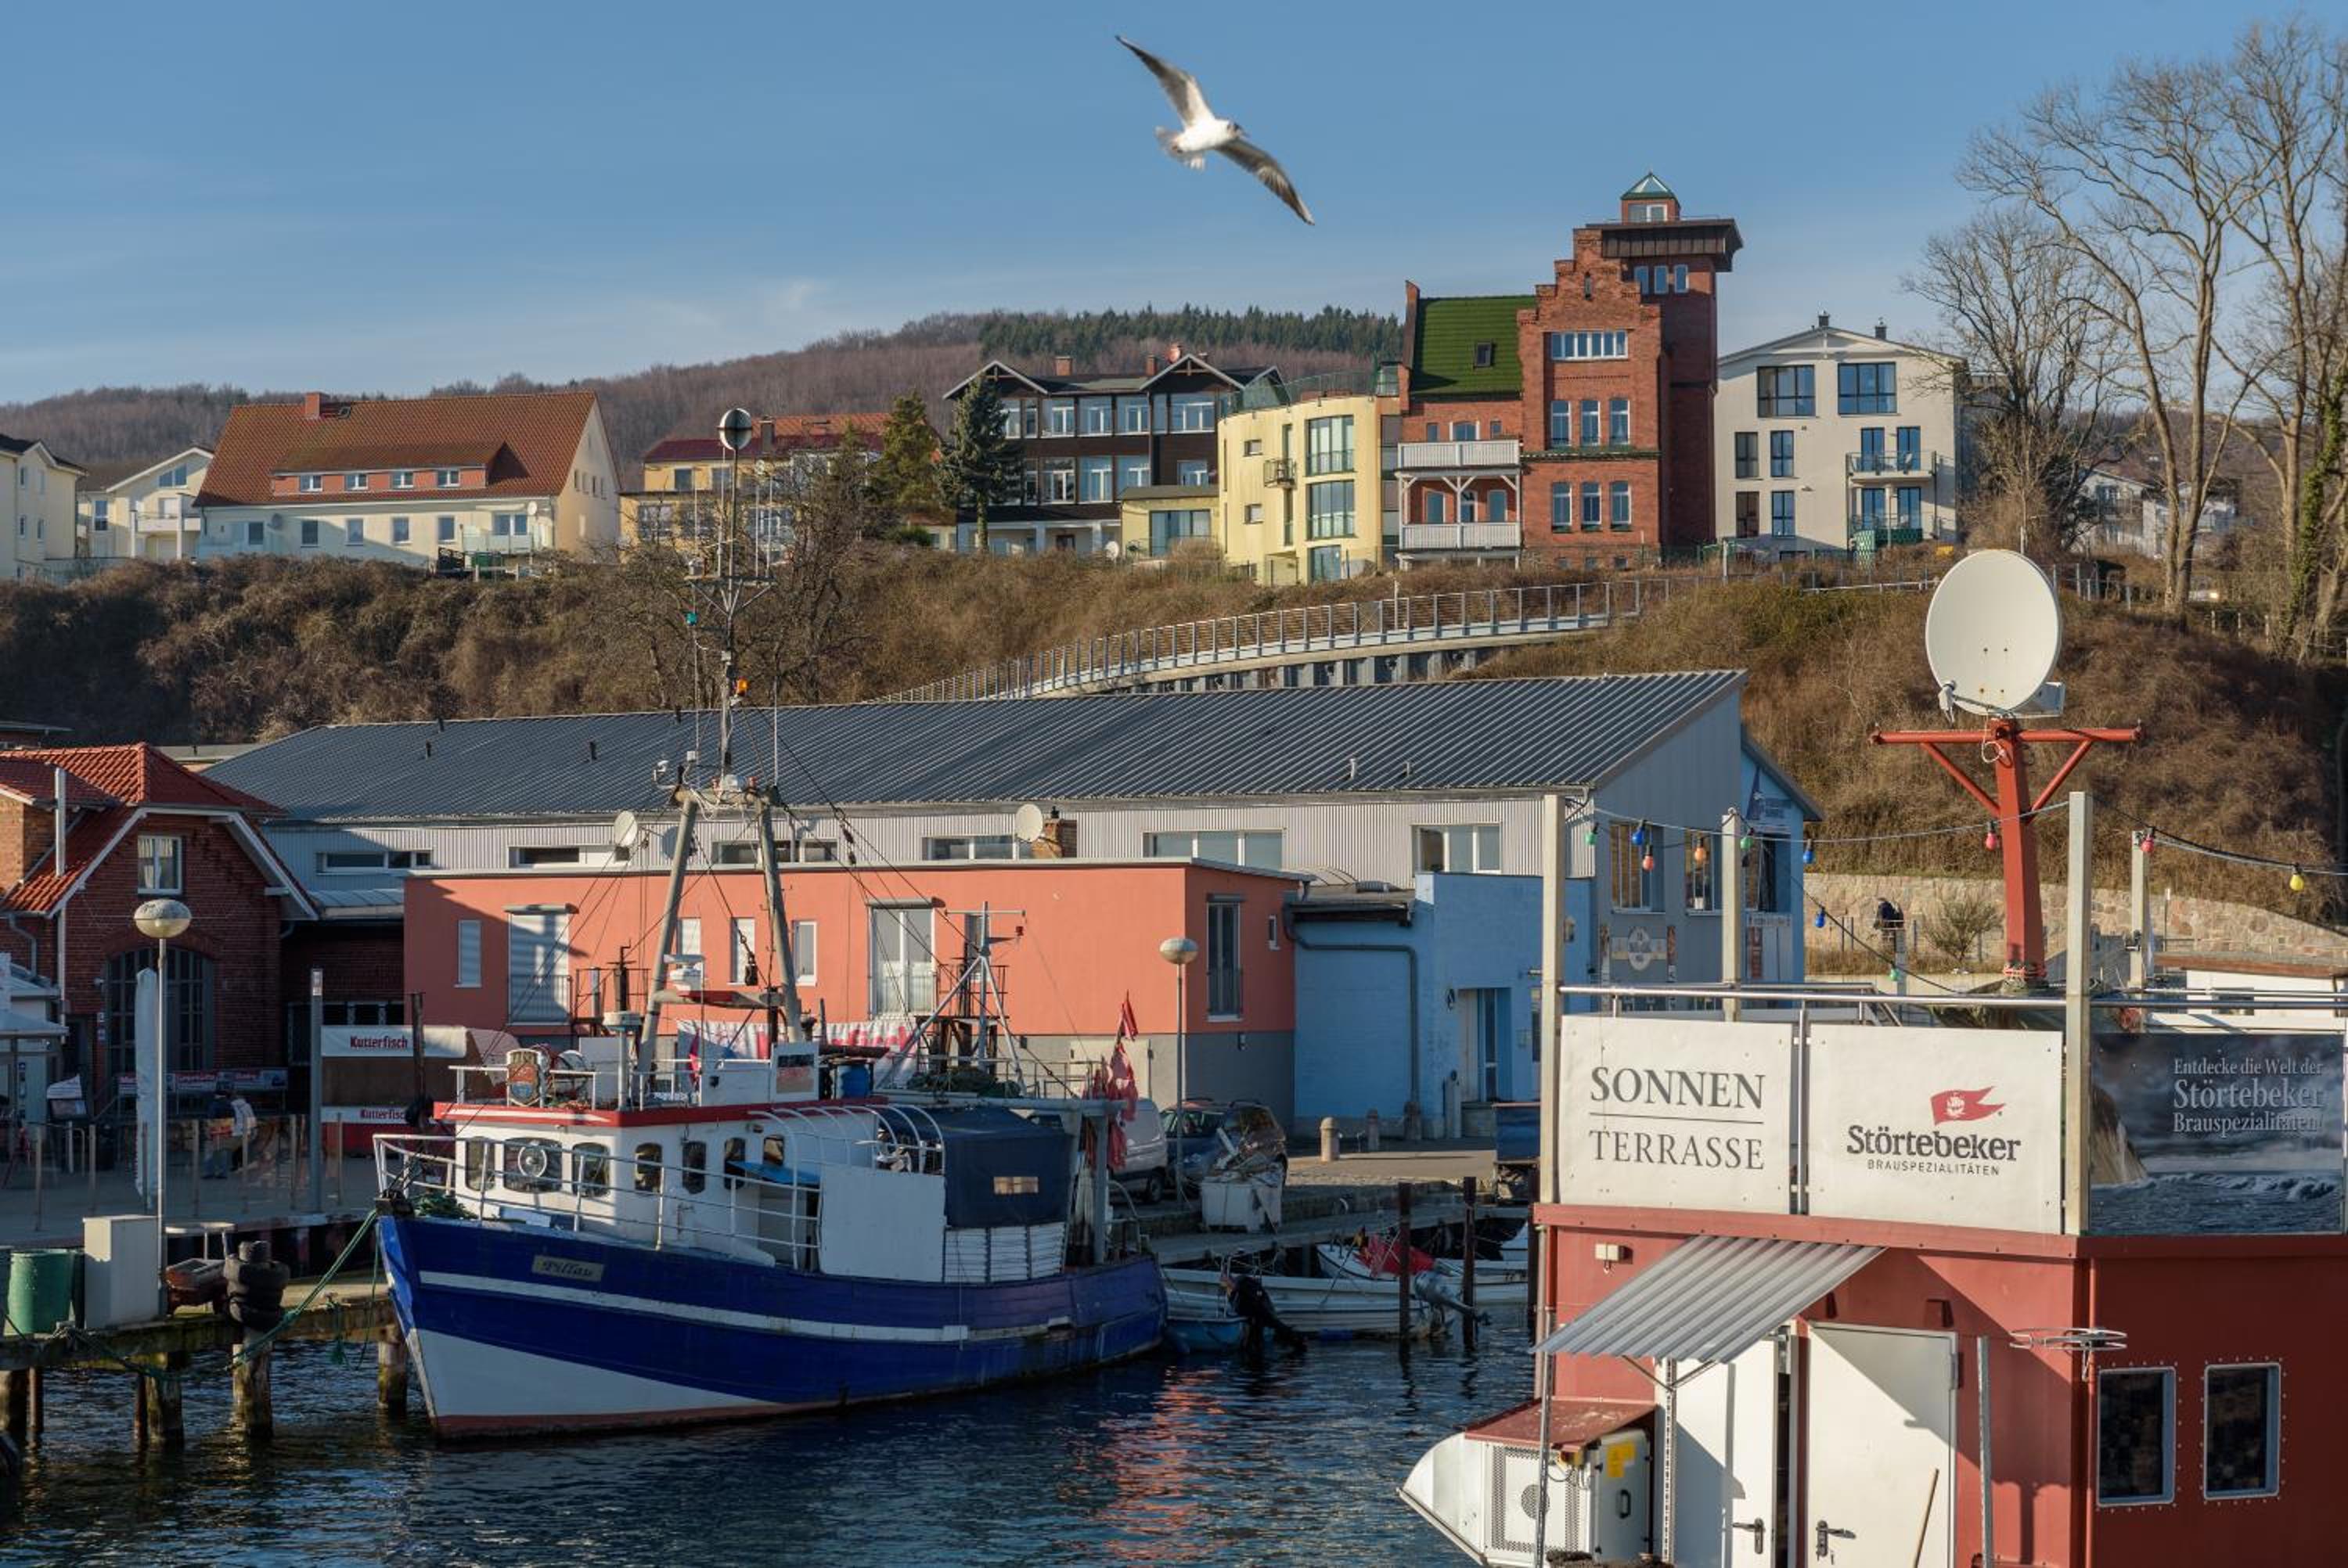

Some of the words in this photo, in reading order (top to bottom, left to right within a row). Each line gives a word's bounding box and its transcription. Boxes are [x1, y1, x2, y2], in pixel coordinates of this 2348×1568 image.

[349, 1034, 408, 1048] Kutterfisch
[2173, 1057, 2238, 1075] Entdecke
[2240, 1057, 2261, 1075] die
[2265, 1058, 2298, 1075] Welt
[2300, 1058, 2324, 1075] der
[1590, 1066, 1766, 1109] SONNEN
[2173, 1077, 2325, 1109] Störtebeker
[359, 1109, 406, 1120] Kutterfisc
[1589, 1130, 1765, 1171] TERRASSE
[1846, 1124, 2022, 1161] Störtebeker
[1867, 1159, 2000, 1175] BRAUSPEZIALITÄTEN
